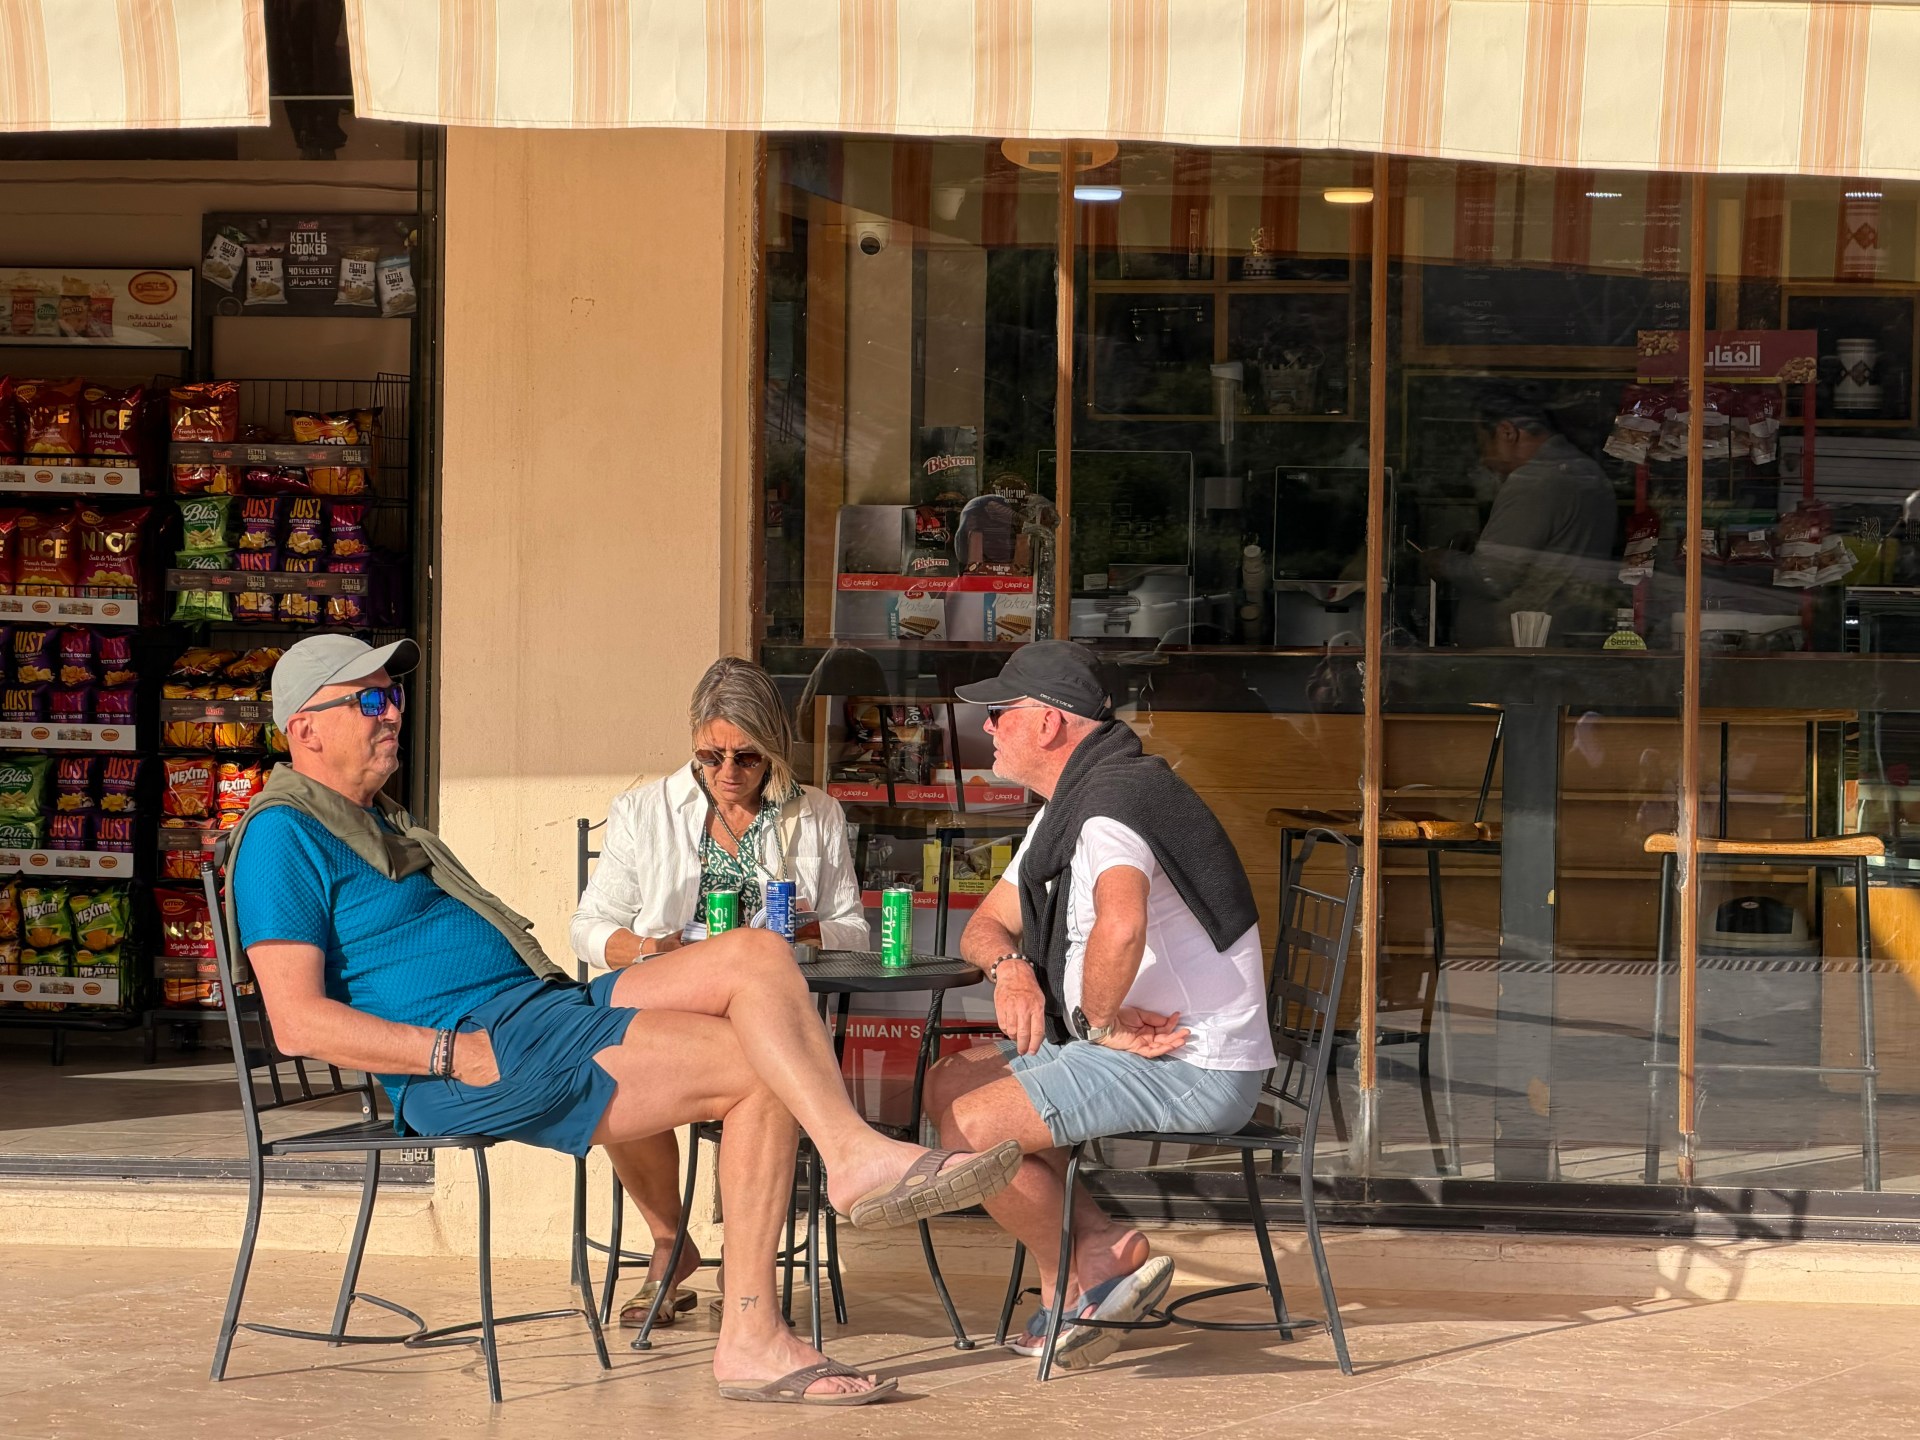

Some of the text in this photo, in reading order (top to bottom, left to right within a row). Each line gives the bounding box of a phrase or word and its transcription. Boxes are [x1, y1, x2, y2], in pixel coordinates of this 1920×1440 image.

[290, 231, 327, 244] KETTLE
[290, 243, 328, 256] COOKED
[289, 267, 333, 275] 40% LESS FAT
[13, 303, 34, 311] NICE
[923, 455, 975, 475] Biskrem
[182, 503, 220, 521] Bliss
[242, 498, 278, 519] JUST
[289, 498, 322, 519] JUST
[106, 555, 129, 563] Vinegar
[187, 556, 221, 570] Bliss
[239, 553, 271, 571] JUST
[285, 558, 316, 572] JUST
[912, 557, 949, 571] Biskrem
[14, 631, 46, 653] JUST
[1610, 637, 1639, 646] Secret
[2, 690, 36, 711] JUST
[1, 767, 33, 784] Bliss
[57, 758, 92, 780] JUST
[104, 757, 141, 780] JUST
[169, 767, 209, 786] MEXITA
[217, 778, 252, 795] MEXITA
[49, 815, 85, 838] JUST
[96, 817, 132, 840] JUST
[23, 902, 58, 920] MEXITA
[75, 902, 110, 924] MEXITA
[785, 896, 796, 938] kinza
[169, 942, 209, 951] Lightly Salted
